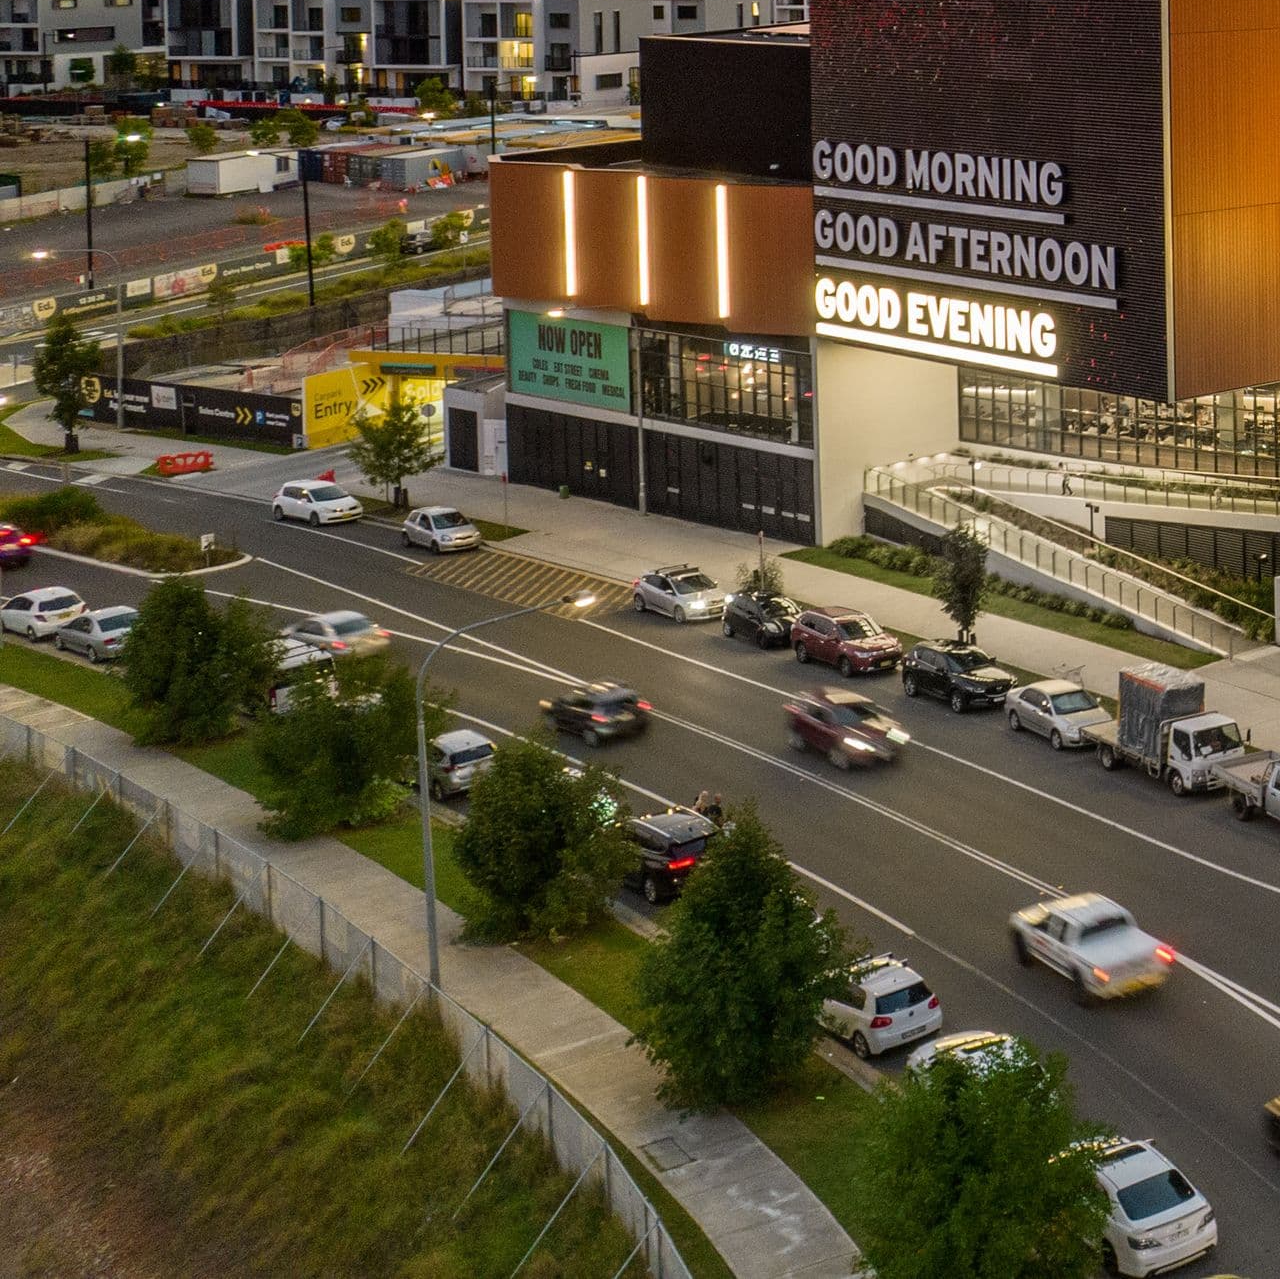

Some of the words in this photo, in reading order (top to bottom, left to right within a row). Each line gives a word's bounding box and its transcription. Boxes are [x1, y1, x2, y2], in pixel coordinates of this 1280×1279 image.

[812, 139, 897, 187] GOOD
[905, 149, 1064, 207] MORNING
[814, 208, 899, 258] GOOD
[905, 221, 1116, 290] AFTERNOON
[815, 277, 900, 330] GOOD
[906, 292, 1058, 359] EVENING
[538, 324, 566, 353] NOW
[570, 329, 602, 360] OPEN
[518, 370, 537, 383] BEAUTY
[564, 364, 583, 377] STREET
[589, 368, 609, 381] CINEMA
[565, 378, 581, 391] FRESH
[581, 381, 596, 393] FOOD
[314, 401, 352, 419] Entry
